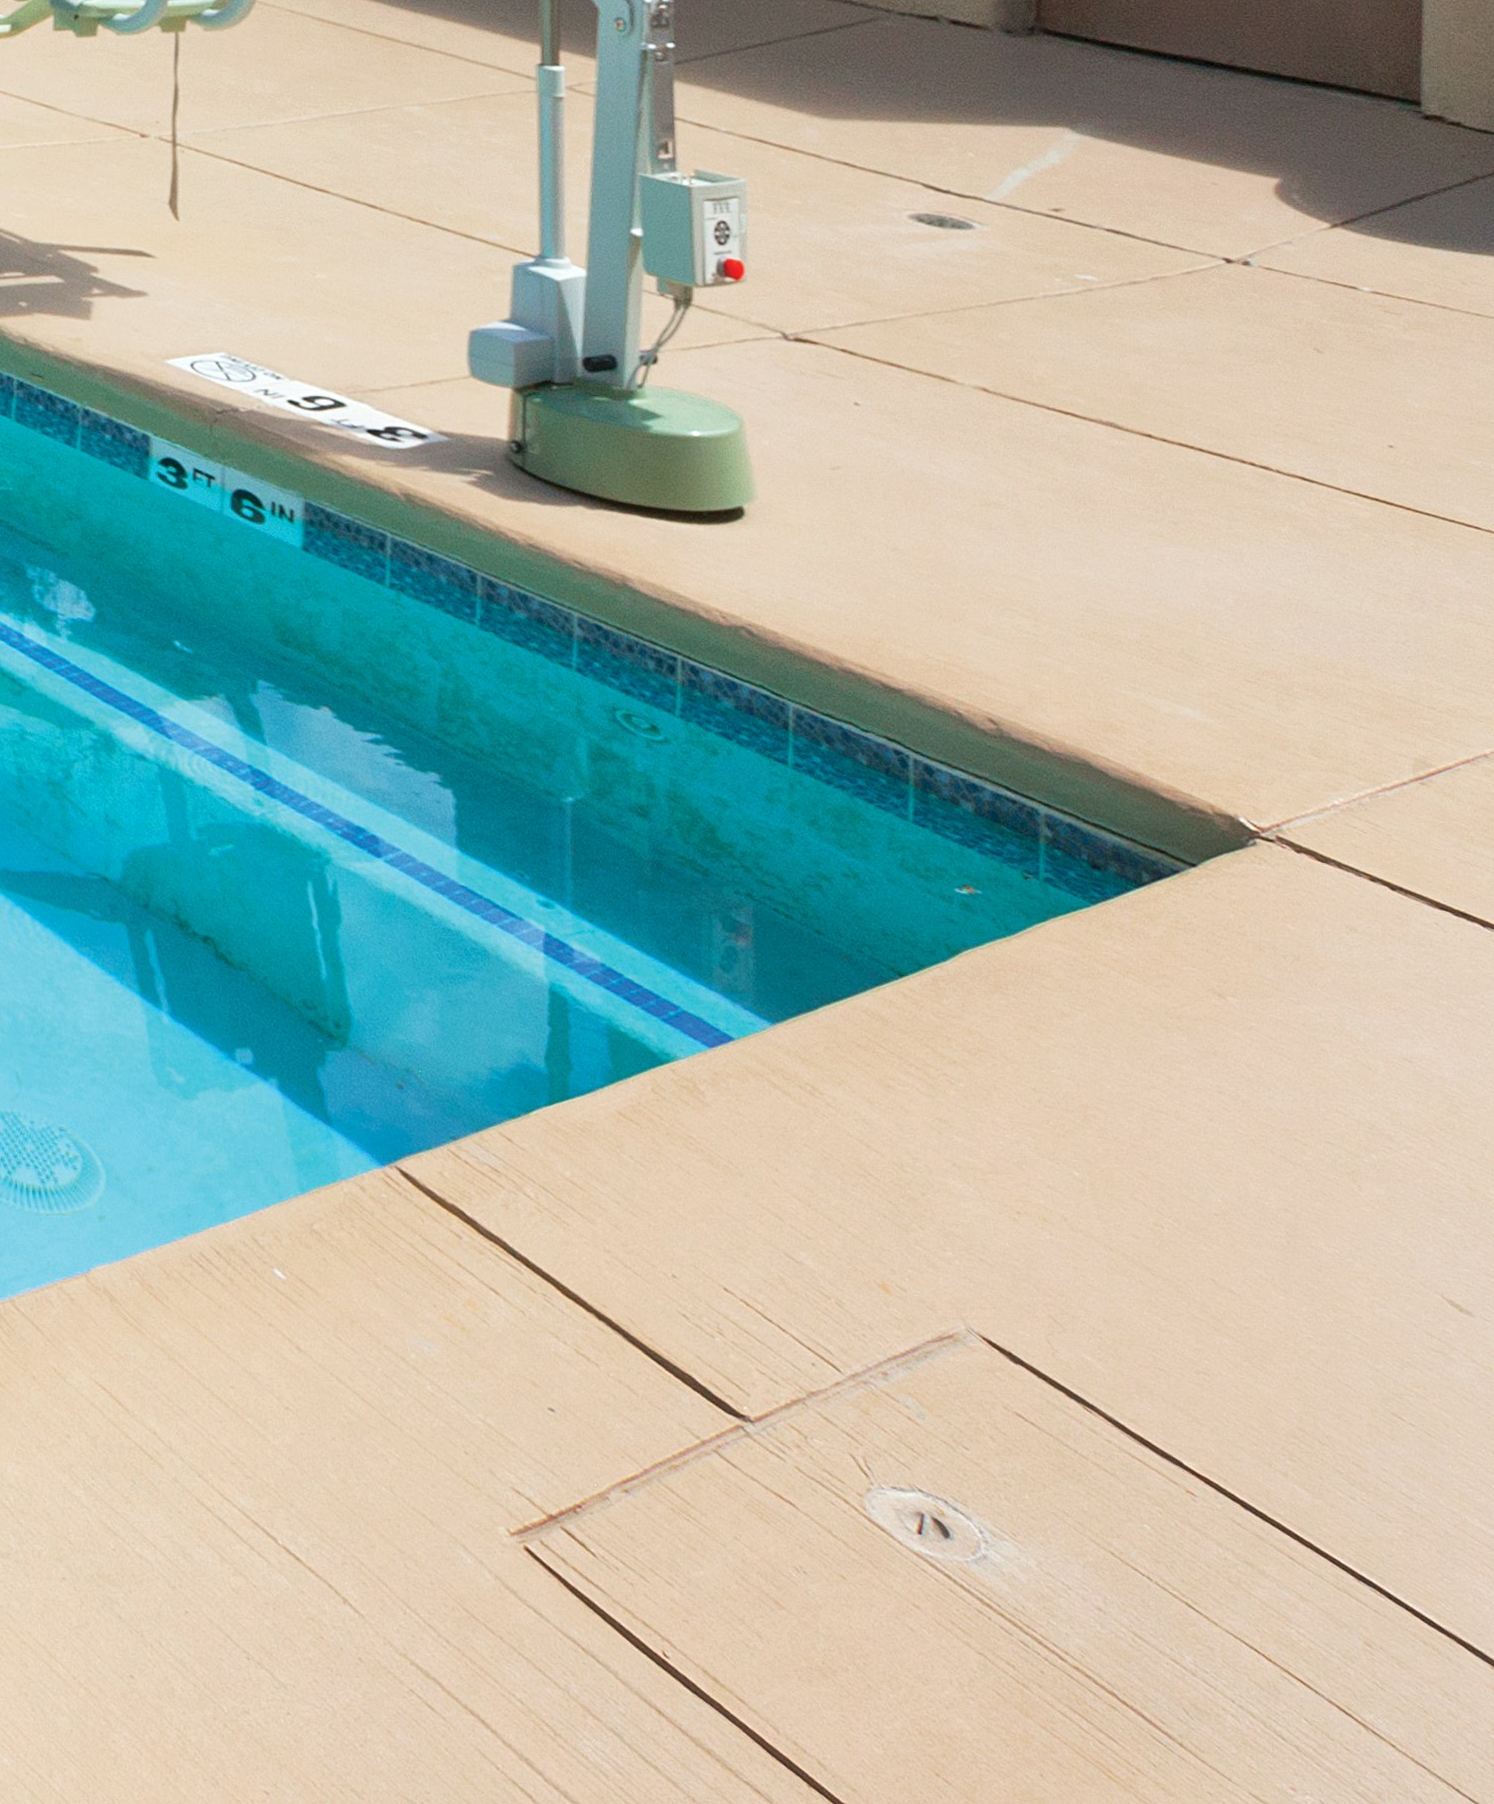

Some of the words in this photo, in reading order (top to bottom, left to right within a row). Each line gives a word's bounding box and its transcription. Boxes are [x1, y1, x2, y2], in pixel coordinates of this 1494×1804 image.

[287, 395, 347, 412] 6
[366, 426, 427, 443] 3
[156, 457, 188, 490] 3
[192, 469, 216, 489] FT
[230, 489, 266, 525] 6
[270, 501, 295, 524] IN
